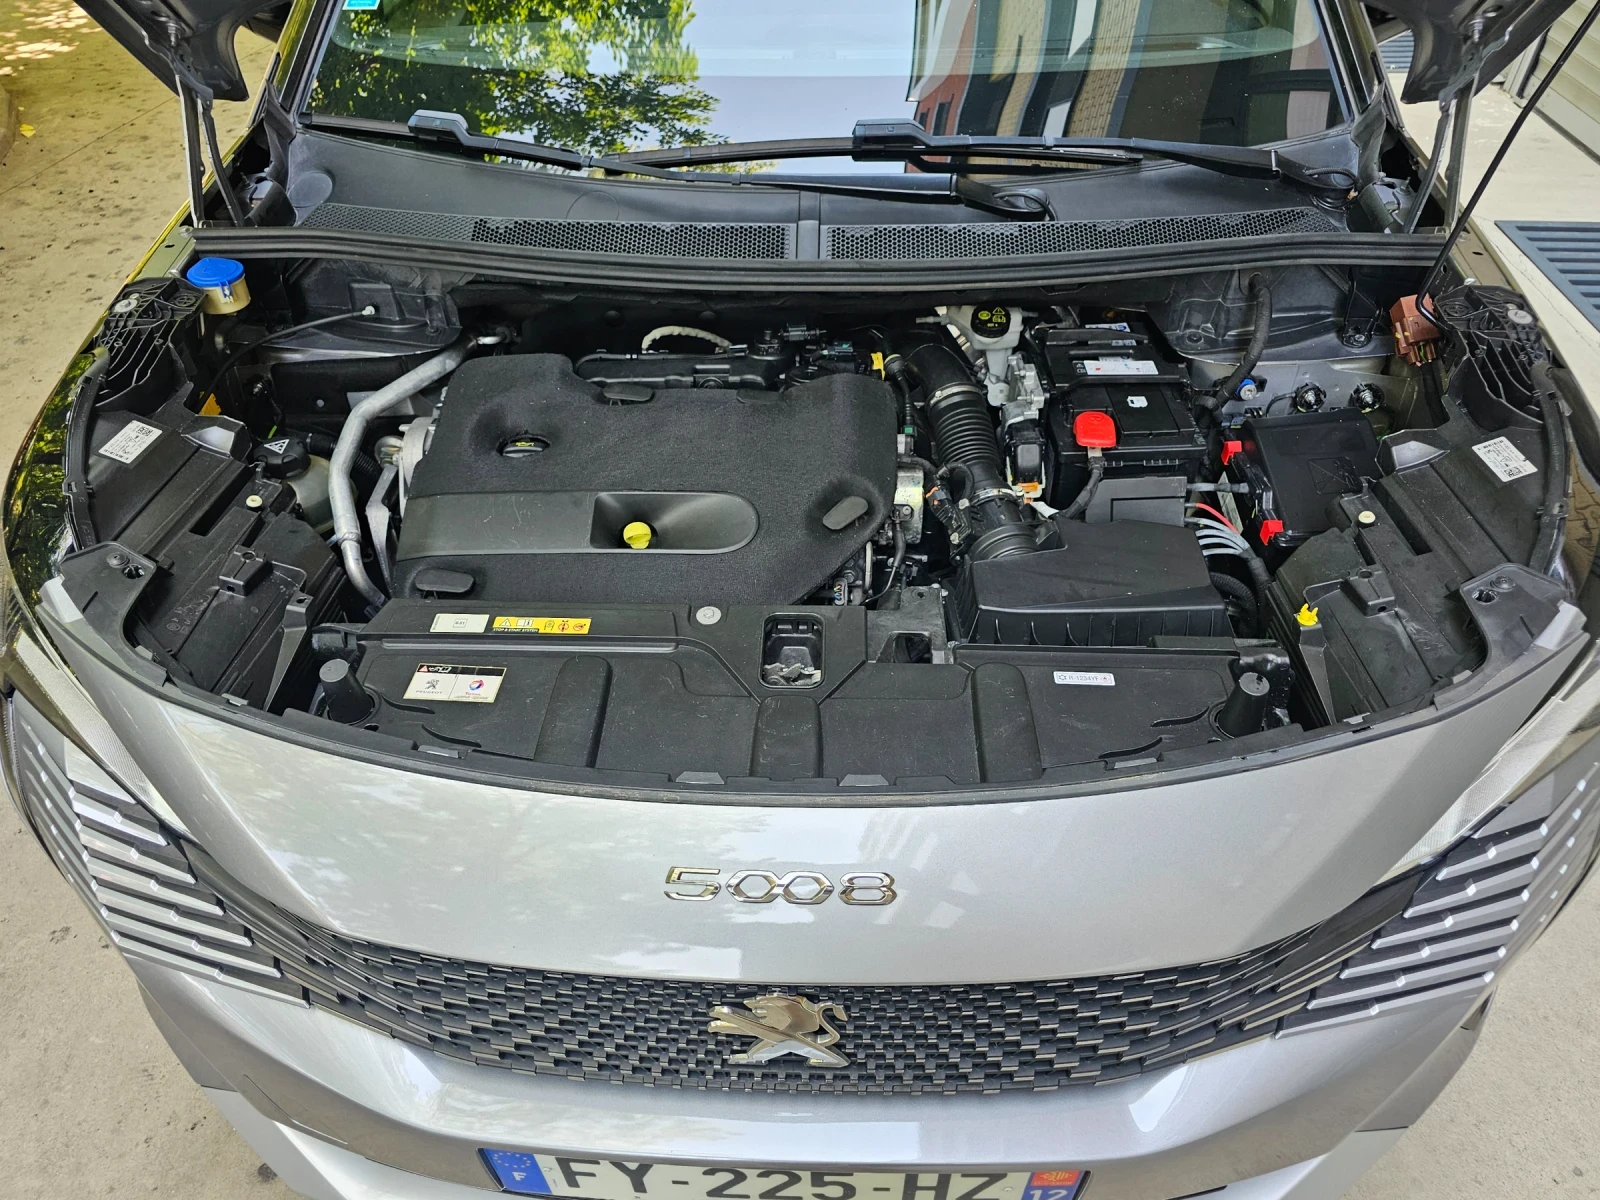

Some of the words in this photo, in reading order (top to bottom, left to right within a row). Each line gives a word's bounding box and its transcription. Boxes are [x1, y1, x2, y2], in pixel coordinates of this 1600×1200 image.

[664, 866, 897, 905] 5008
[513, 1171, 526, 1181] F
[555, 1156, 1008, 1200] FY-225-HZ
[1030, 1190, 1068, 1200] 12
